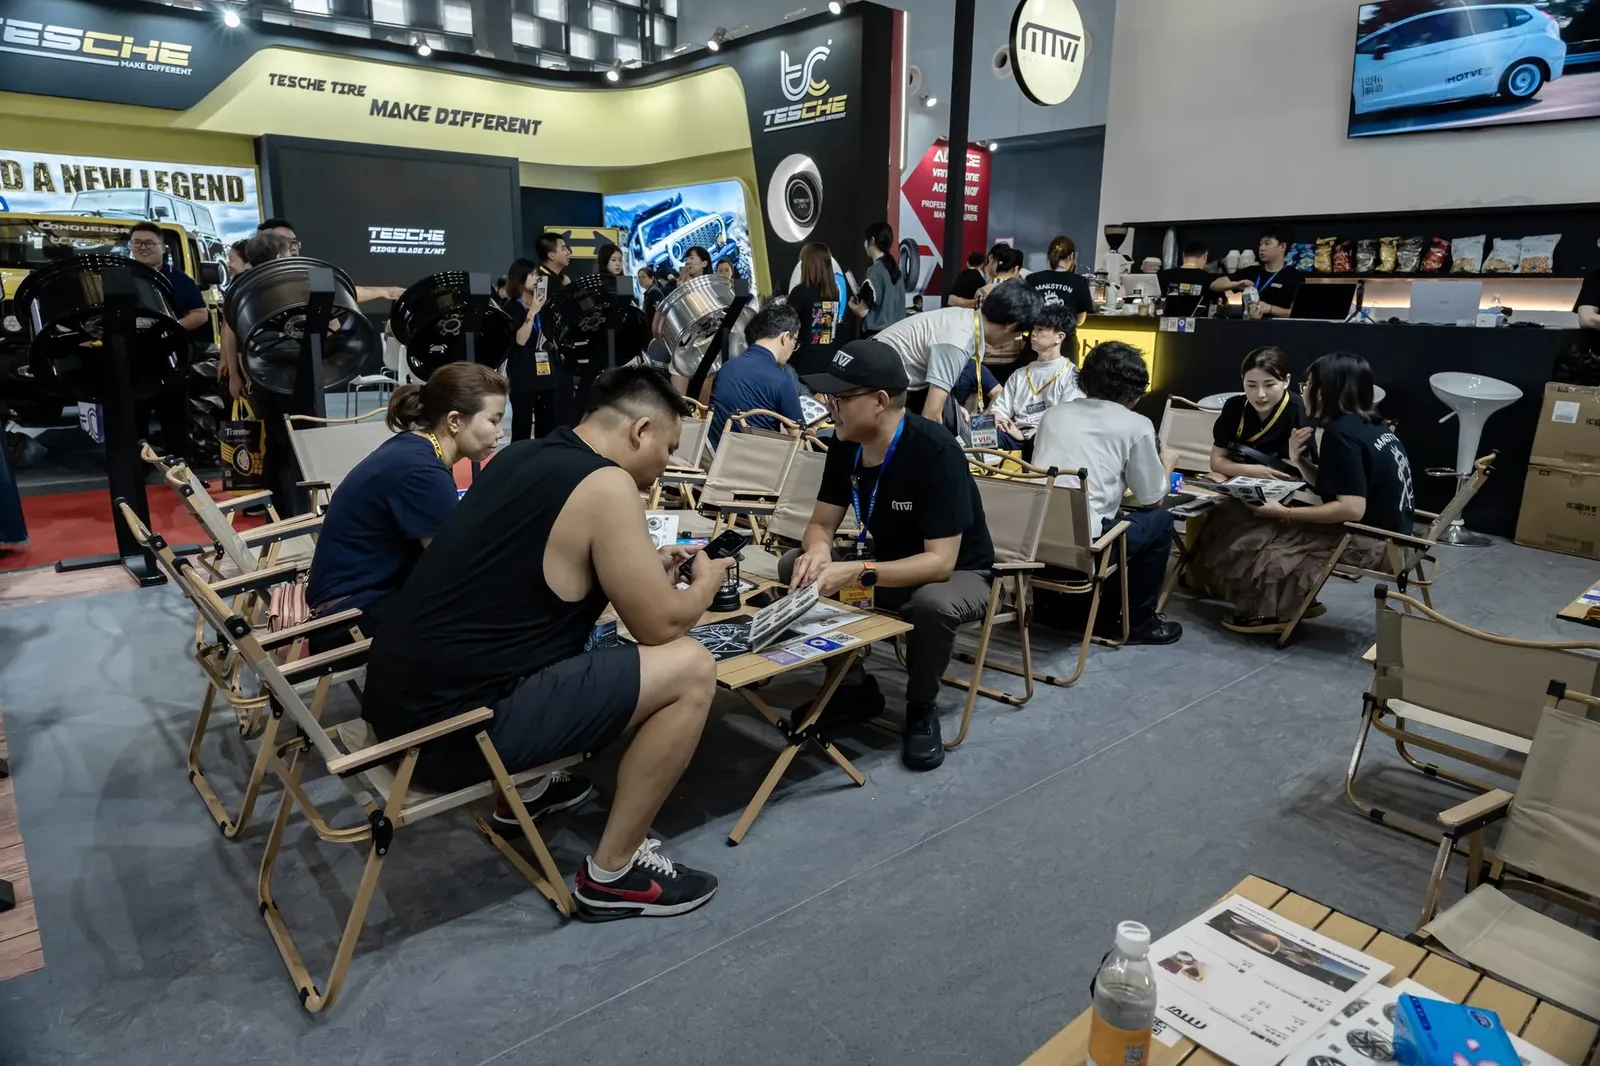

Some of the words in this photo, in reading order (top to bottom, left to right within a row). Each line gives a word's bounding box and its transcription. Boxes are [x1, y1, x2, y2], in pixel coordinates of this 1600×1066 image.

[0, 17, 192, 66] ESCHE
[121, 60, 146, 70] MAKE
[147, 63, 192, 76] DIFFERENT
[268, 73, 327, 92] TESCHE
[330, 81, 367, 97] TIRE
[369, 98, 432, 122] MAKE
[434, 107, 543, 136] DIFFERENT
[763, 94, 848, 126] TESCHE
[33, 162, 56, 193] A
[60, 163, 132, 194] NEW
[140, 168, 247, 204] LEGEND
[368, 226, 445, 242] TESCHE
[397, 246, 423, 254] BLADE
[424, 247, 446, 255] X/MT
[1035, 283, 1074, 294] MAKSTTON
[978, 435, 991, 443] VIP
